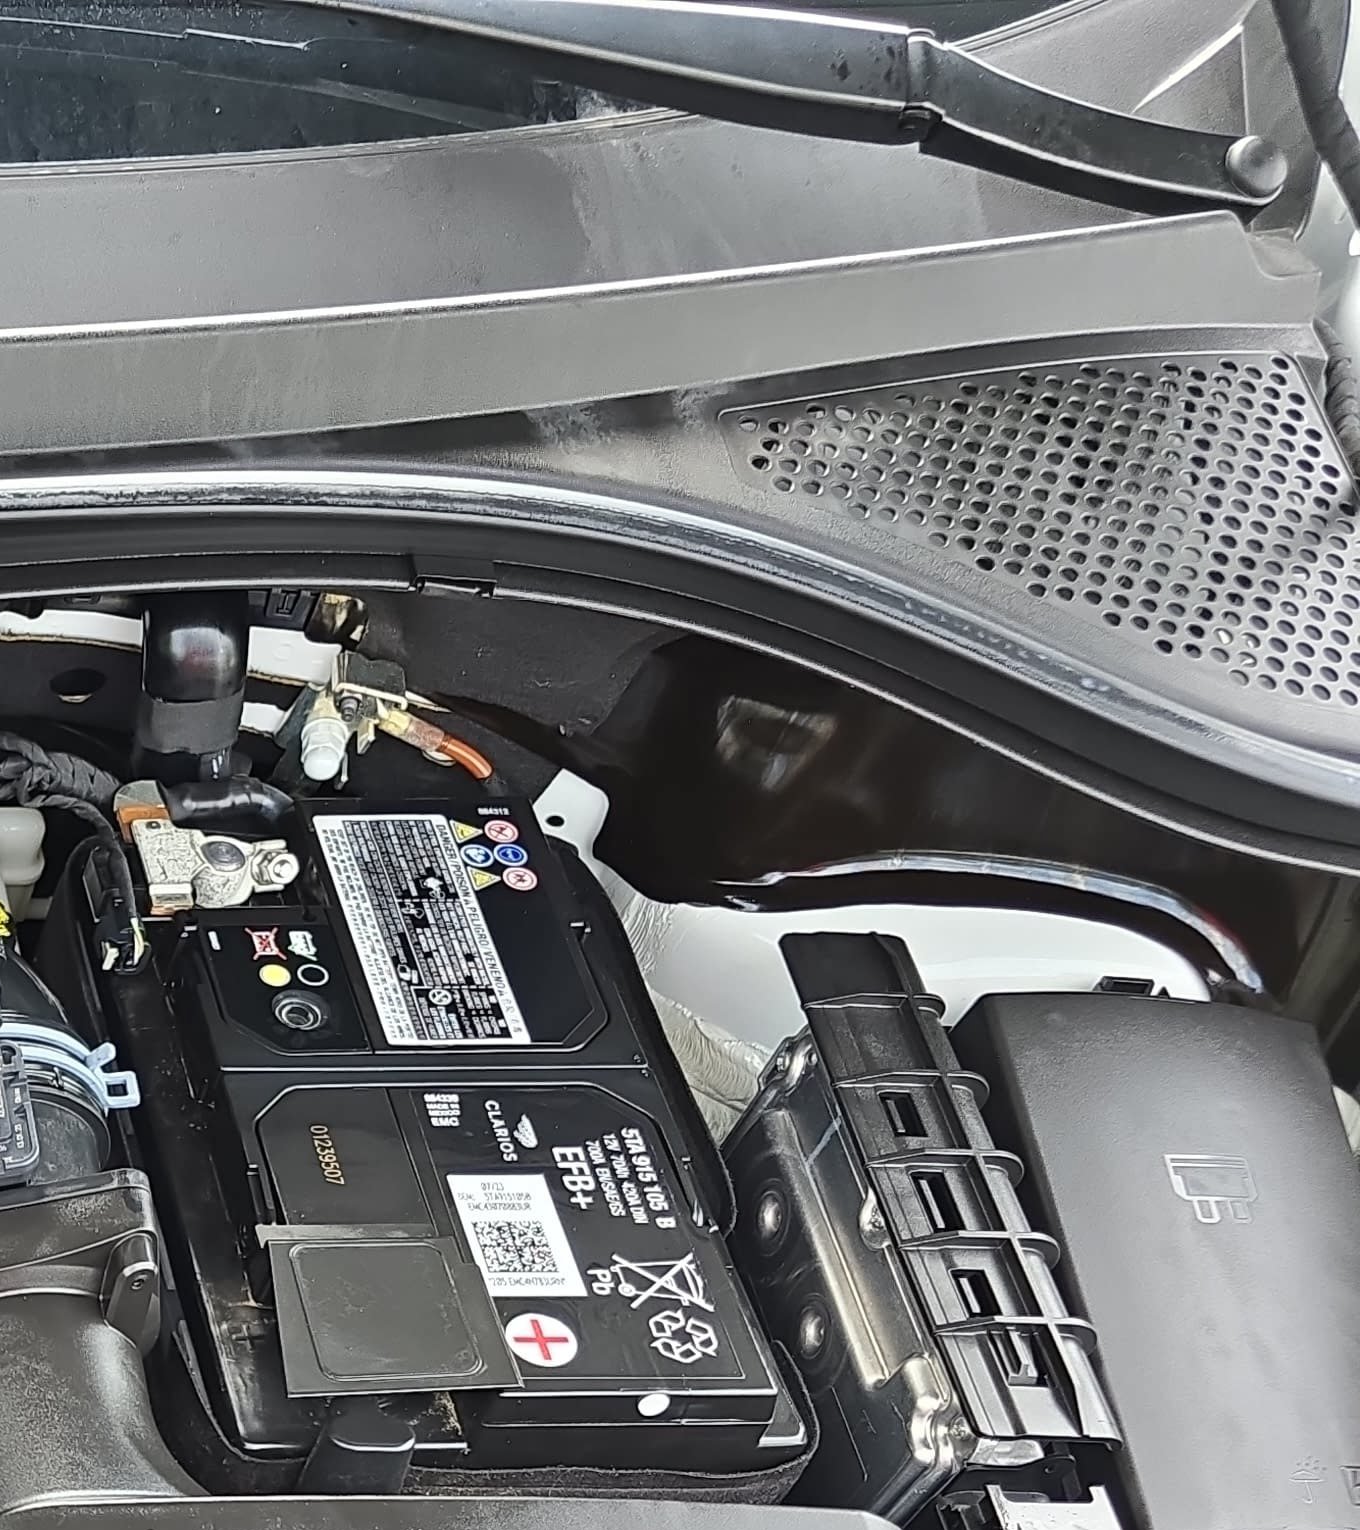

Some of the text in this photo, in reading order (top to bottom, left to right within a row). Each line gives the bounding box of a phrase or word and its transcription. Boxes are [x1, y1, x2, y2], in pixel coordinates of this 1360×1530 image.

[312, 1124, 346, 1188] 01239507
[484, 1099, 519, 1163] CLARIOS
[585, 1139, 607, 1166] 700A
[551, 1146, 597, 1211] EFB+
[601, 1131, 620, 1153] 12V
[628, 1205, 650, 1225] DIN
[620, 1127, 677, 1230] 5TA 915 105 B
[586, 1266, 613, 1297] Pb
